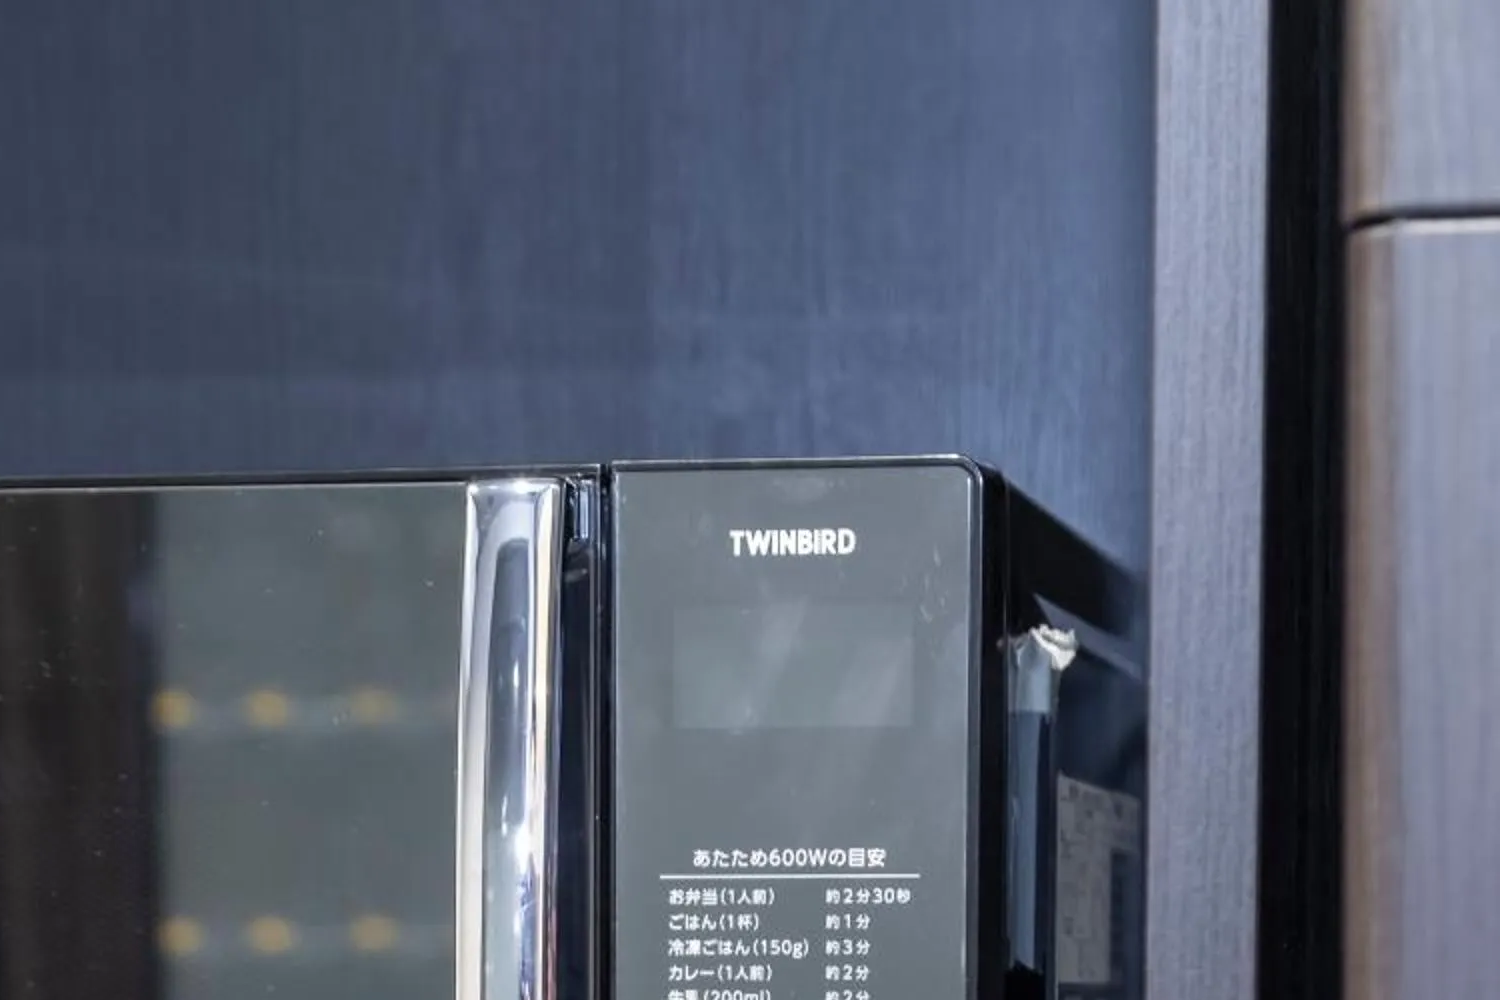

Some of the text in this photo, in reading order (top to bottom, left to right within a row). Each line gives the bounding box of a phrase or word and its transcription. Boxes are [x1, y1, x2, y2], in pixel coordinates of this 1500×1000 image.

[729, 528, 857, 557] TWINBIRD
[692, 848, 887, 869] あたため600Wの目安
[825, 914, 871, 929] 約1分
[825, 940, 871, 955] 約3分
[825, 965, 870, 981] 約2分
